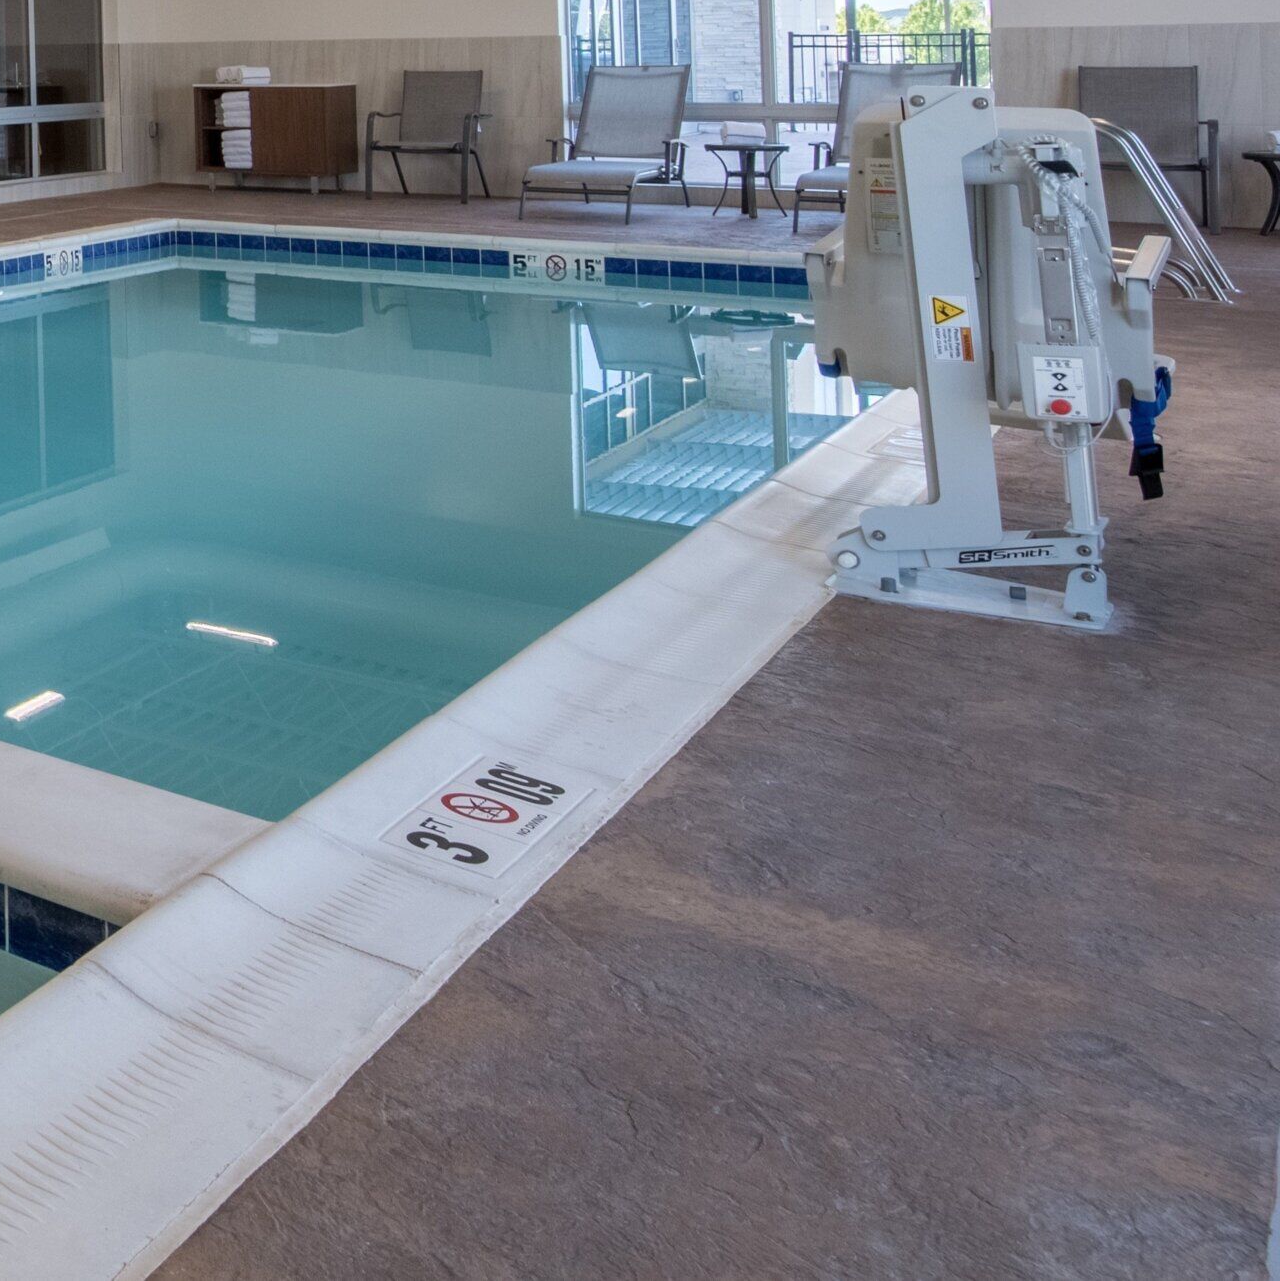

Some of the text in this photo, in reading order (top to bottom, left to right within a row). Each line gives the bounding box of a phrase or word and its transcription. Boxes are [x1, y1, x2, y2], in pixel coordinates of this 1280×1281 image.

[960, 548, 1050, 563] SR Smith
[495, 761, 519, 771] M
[516, 813, 548, 837] NO DIVING
[406, 816, 490, 865] 3 FT
